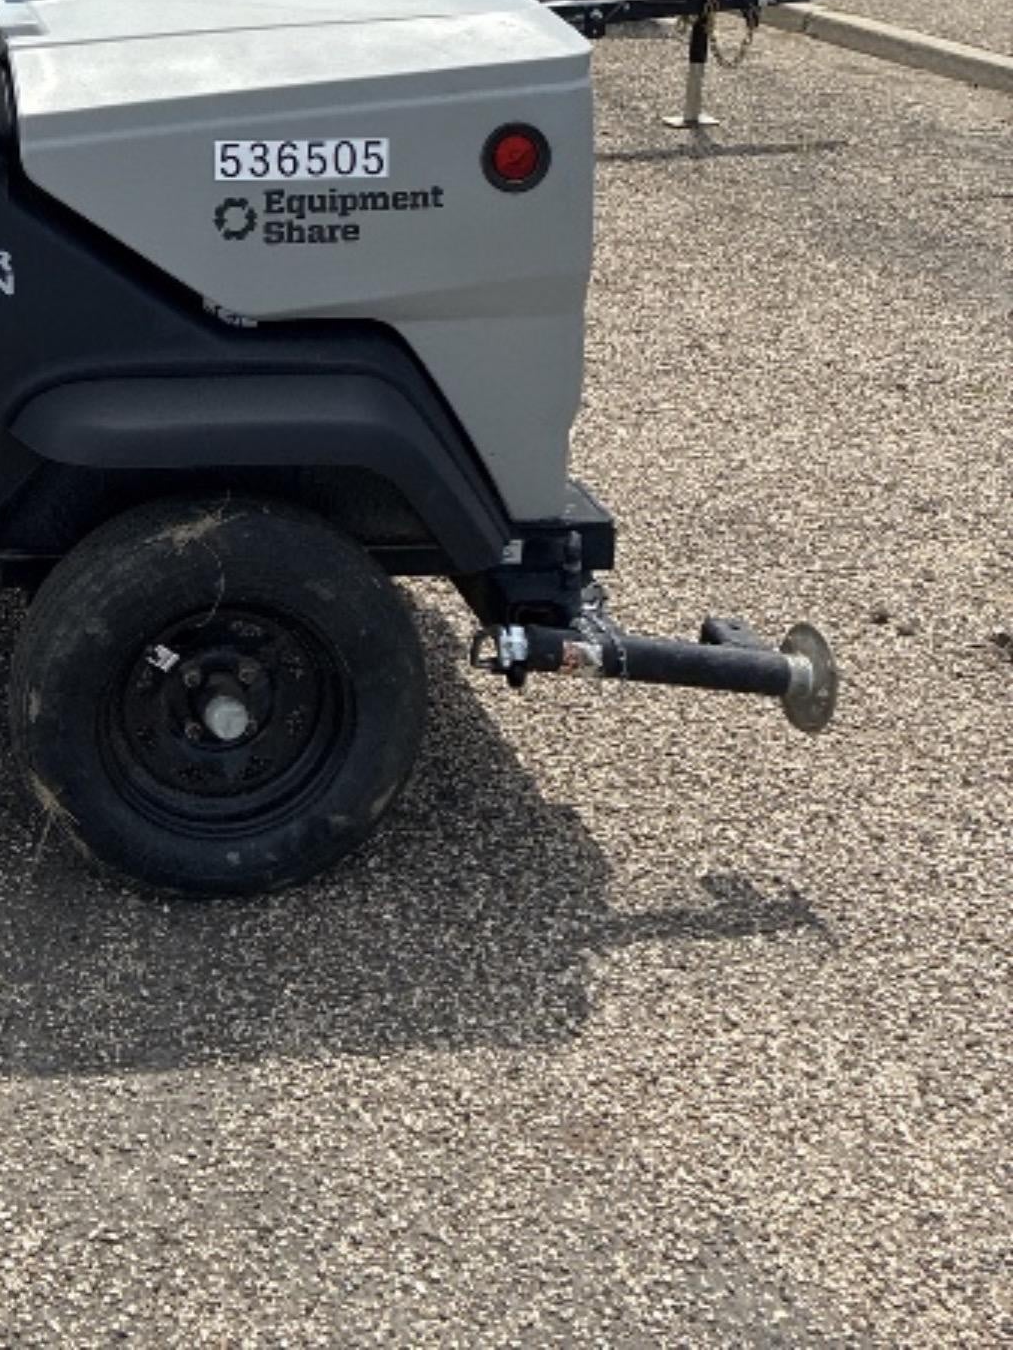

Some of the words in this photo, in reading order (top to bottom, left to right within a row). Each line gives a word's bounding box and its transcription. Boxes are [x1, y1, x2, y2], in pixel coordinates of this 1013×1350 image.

[219, 140, 385, 178] 536505
[263, 186, 445, 219] Equipment
[263, 220, 361, 245] Share
